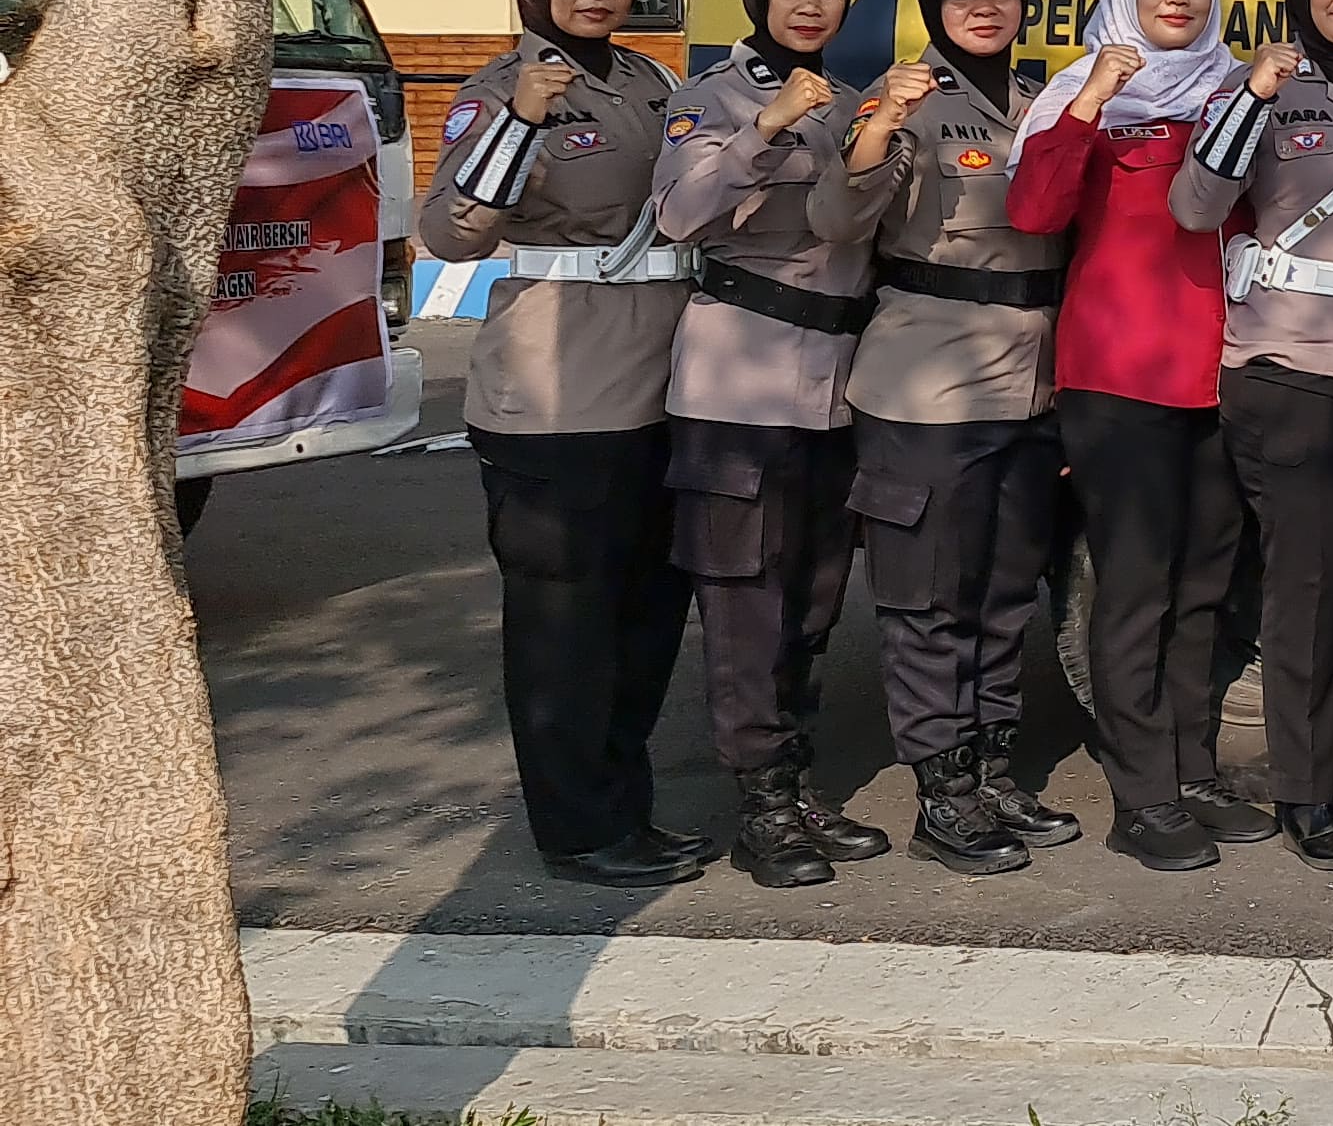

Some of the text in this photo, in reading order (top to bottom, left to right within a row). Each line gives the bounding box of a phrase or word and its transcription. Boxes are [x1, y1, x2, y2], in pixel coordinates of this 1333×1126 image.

[318, 123, 352, 149] BRI
[941, 124, 991, 142] ANIK
[236, 224, 261, 249] AIR
[264, 222, 309, 248] BERSIH
[212, 272, 255, 298] AGEN
